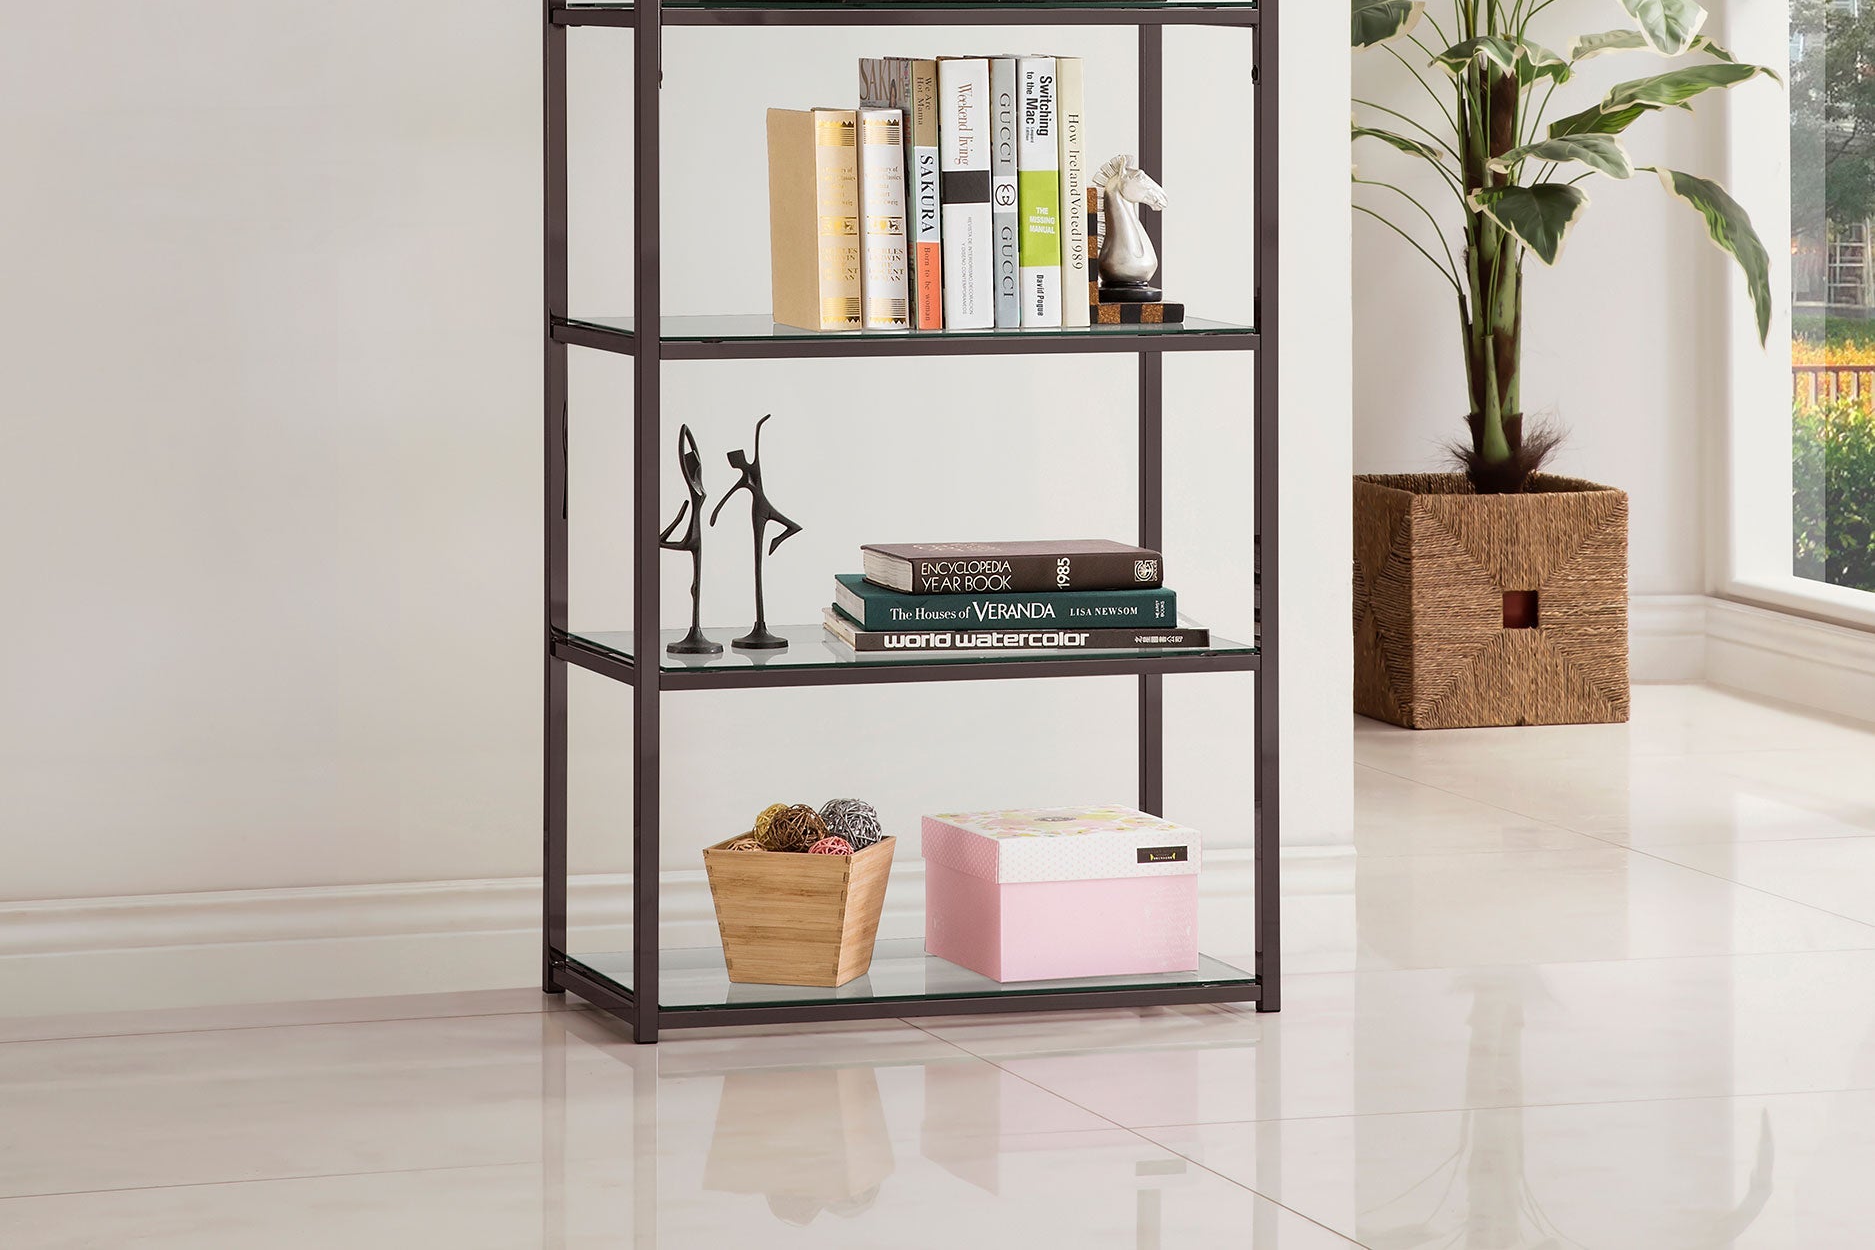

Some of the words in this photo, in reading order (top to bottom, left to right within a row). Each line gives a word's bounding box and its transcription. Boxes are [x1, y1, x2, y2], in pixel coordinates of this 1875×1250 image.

[925, 78, 932, 91] We
[1026, 71, 1034, 80] to
[1026, 82, 1034, 95] the
[957, 83, 973, 131] Weekend
[1026, 98, 1038, 124] Mac
[1036, 76, 1053, 136] Switching
[999, 92, 1011, 164] GUCCI
[1068, 114, 1079, 144] How
[954, 136, 974, 166] living
[920, 155, 934, 234] SAKURA
[1030, 216, 1055, 225] MISSING
[1036, 206, 1048, 214] THE
[1030, 225, 1055, 234] MANUAL
[1001, 226, 1014, 298] GUCCI
[924, 270, 930, 278] to
[924, 282, 931, 290] be
[1036, 295, 1045, 316] Pogue
[921, 560, 1012, 576] ENCYCLOPEDIA
[1056, 557, 1071, 589] 1985
[922, 578, 962, 592] YEAR
[964, 575, 1012, 591] BOOK
[890, 607, 913, 621] The
[915, 607, 956, 620] Houses
[958, 607, 971, 620] of
[972, 601, 1056, 622] VERANDA
[1070, 608, 1092, 616] LISA
[1094, 606, 1138, 616] NEWSOM
[883, 634, 950, 648] world
[955, 631, 1089, 648] watercolor
